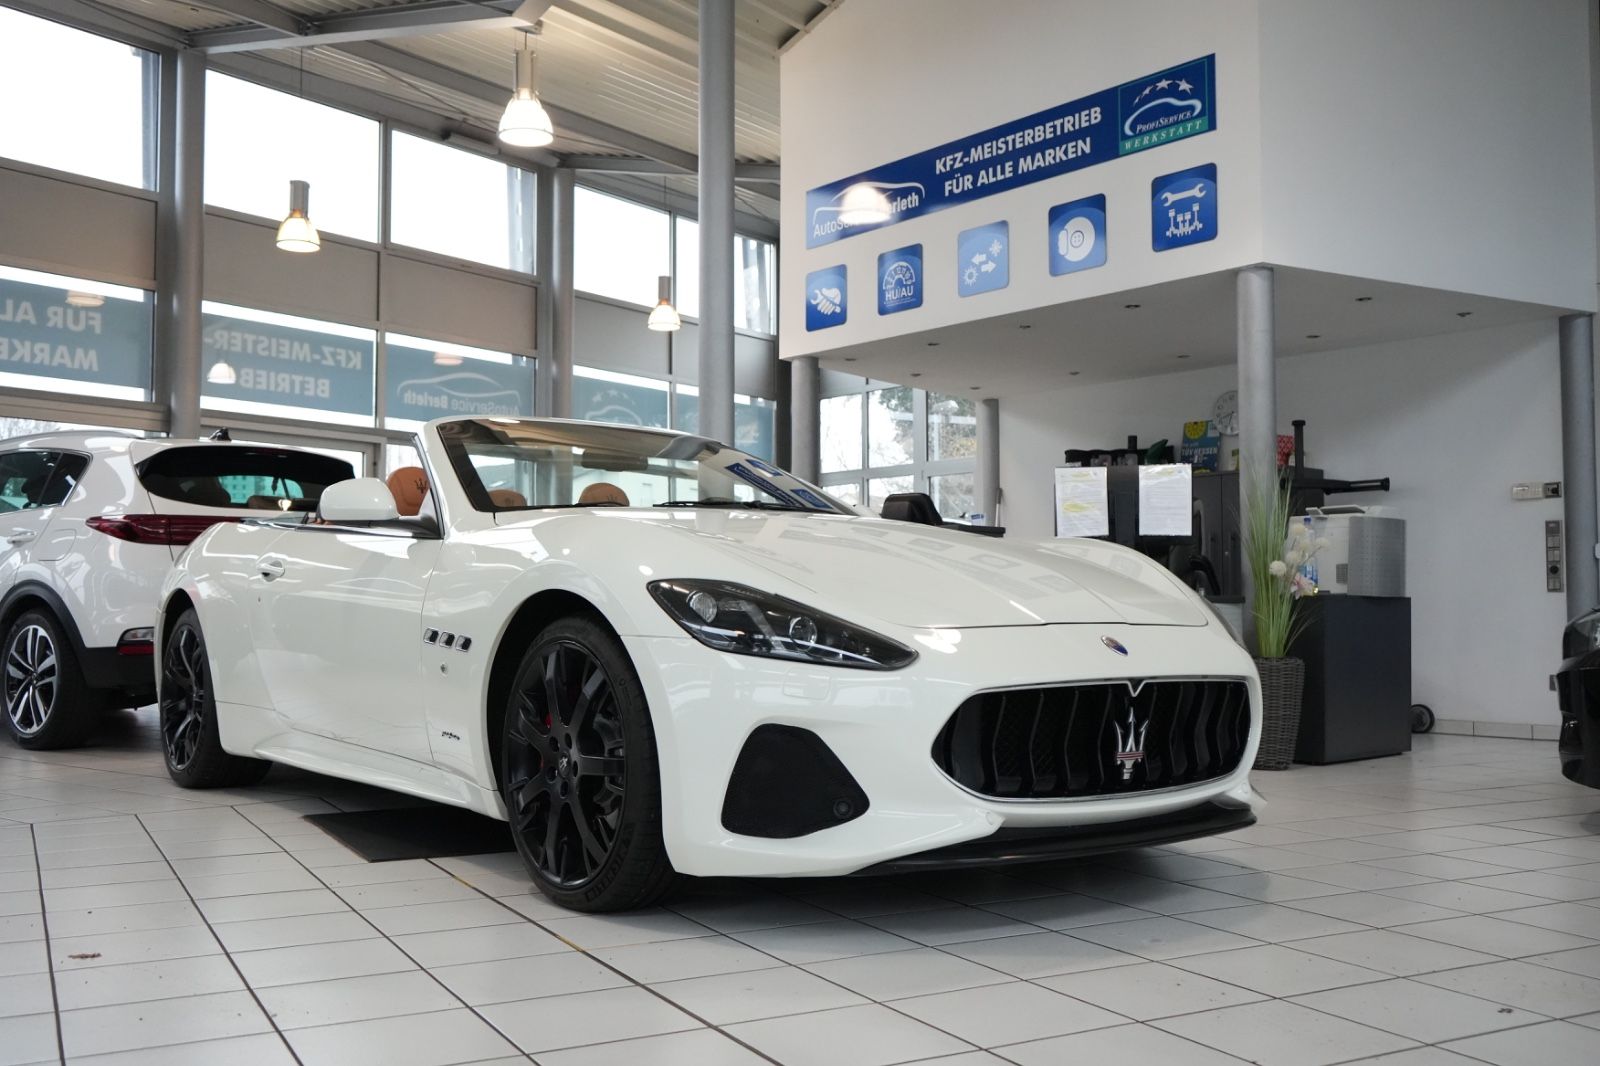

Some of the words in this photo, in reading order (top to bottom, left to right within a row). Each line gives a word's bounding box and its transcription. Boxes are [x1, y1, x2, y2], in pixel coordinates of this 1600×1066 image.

[935, 106, 1102, 175] KFZ-MEISTERBETRIEB
[1124, 120, 1203, 151] WERKSTATT
[943, 173, 974, 198] FÜR
[978, 162, 1014, 187] ALLE
[1018, 137, 1091, 173] MARKEN
[885, 286, 914, 301] HU/AU
